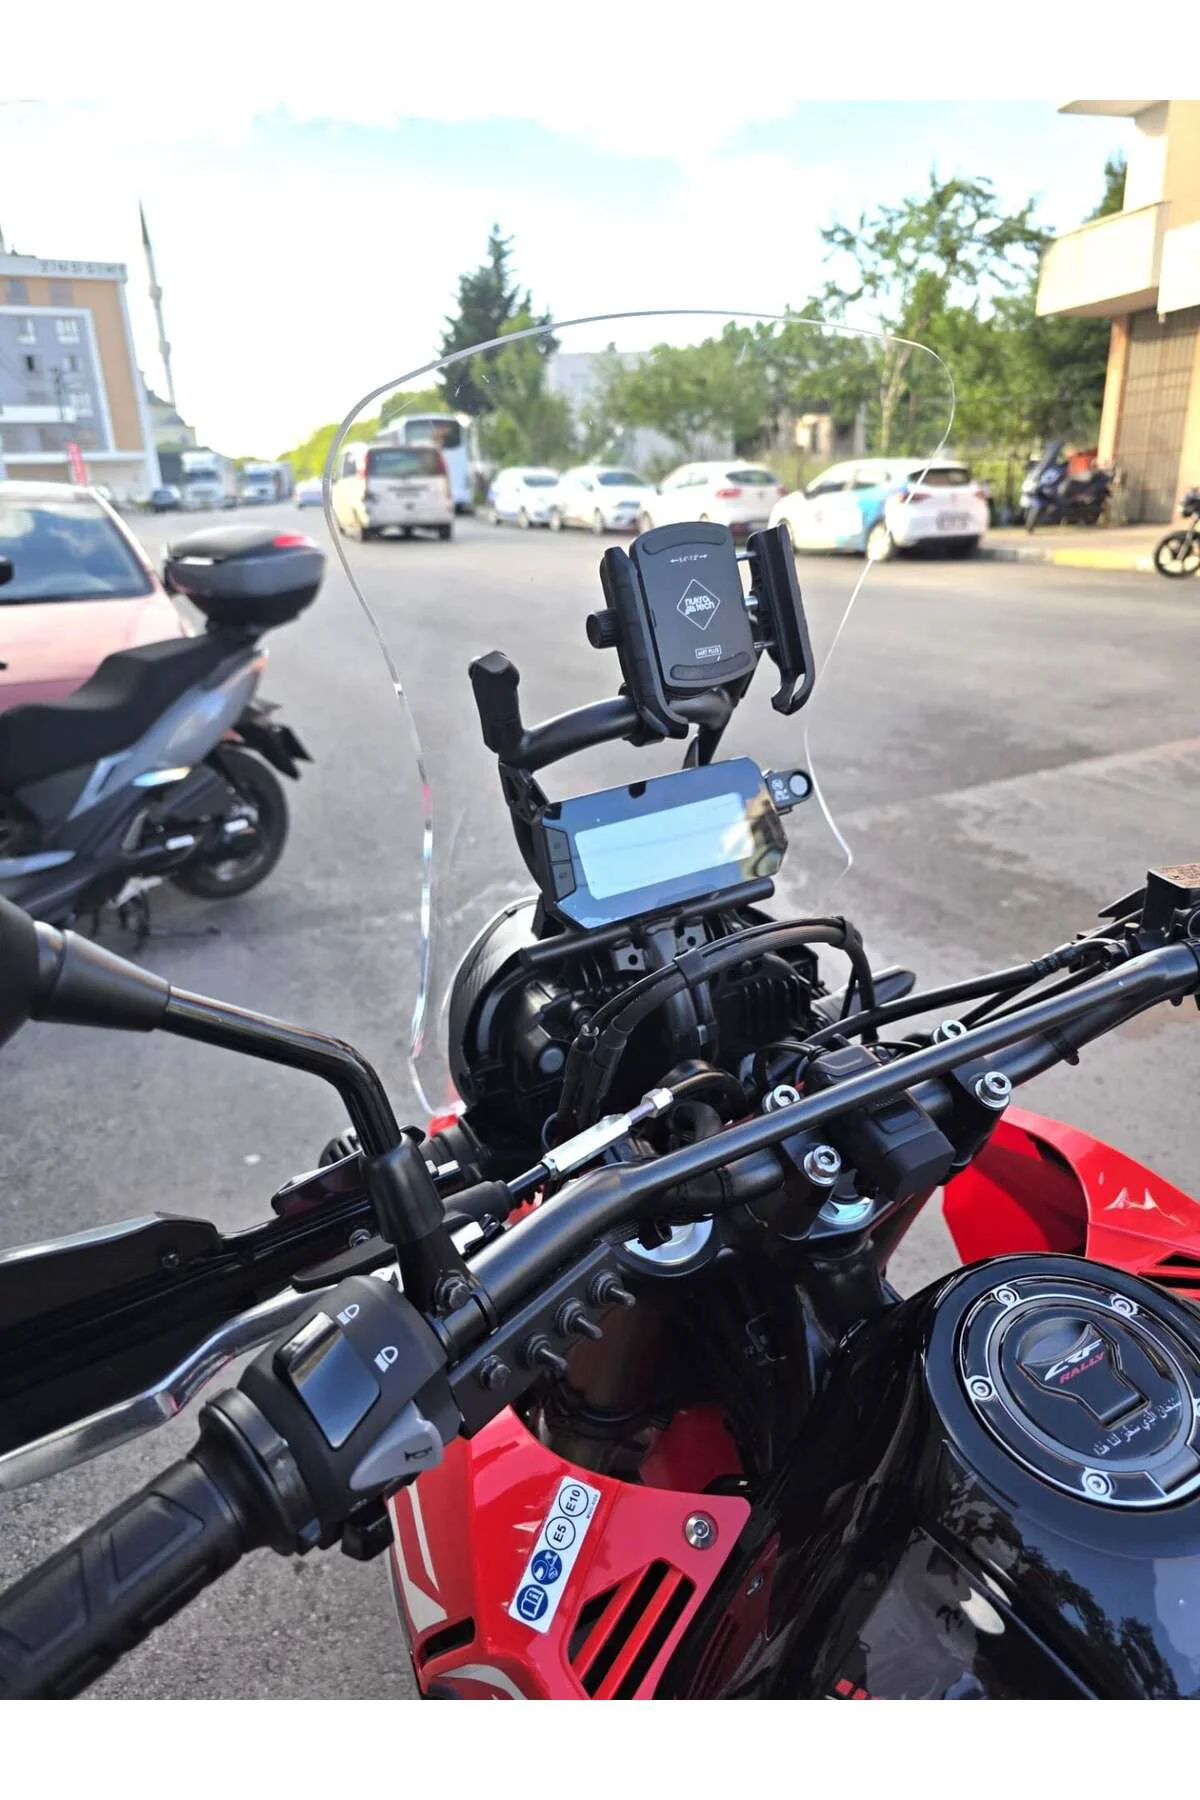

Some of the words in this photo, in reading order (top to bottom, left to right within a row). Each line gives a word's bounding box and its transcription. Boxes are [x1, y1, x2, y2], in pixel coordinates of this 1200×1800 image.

[1044, 1338, 1102, 1381] CRF
[1060, 1351, 1105, 1384] RALLY
[565, 1489, 581, 1512] E10
[553, 1524, 567, 1543] E5
